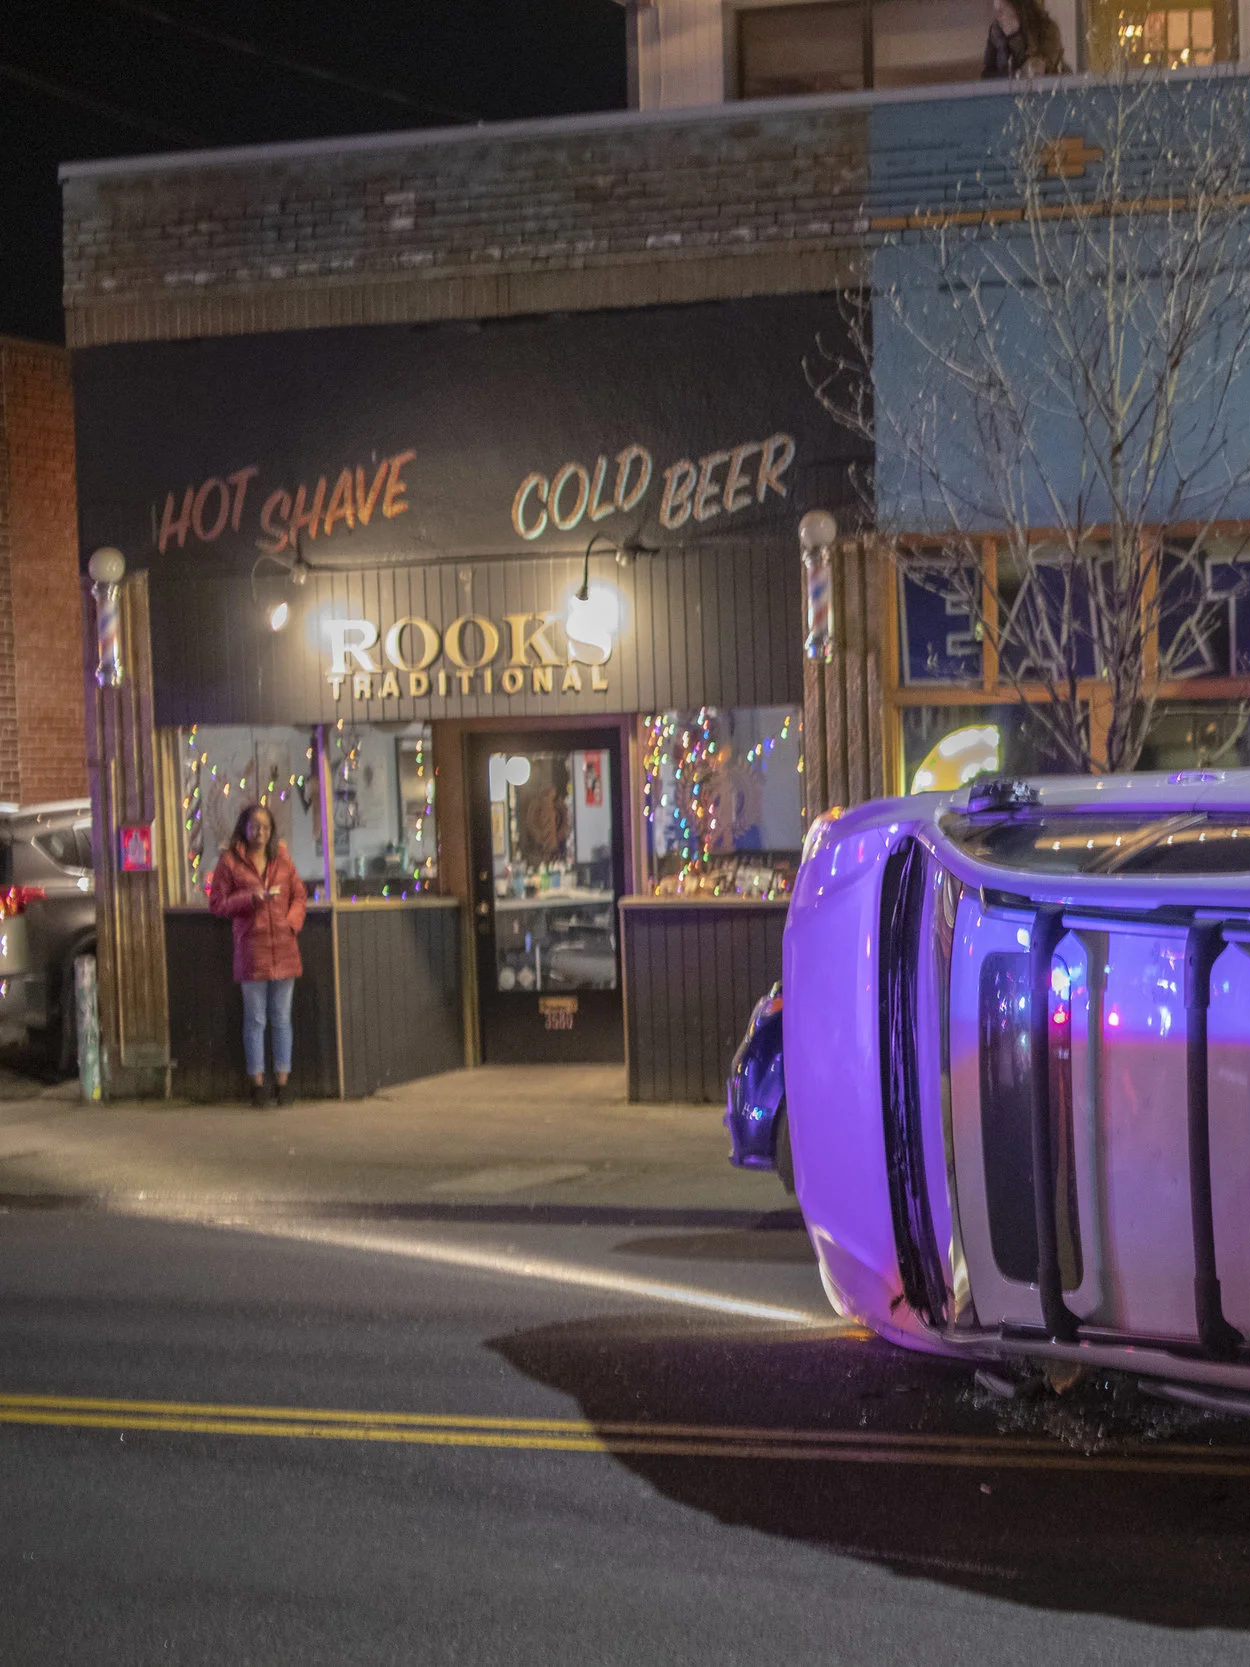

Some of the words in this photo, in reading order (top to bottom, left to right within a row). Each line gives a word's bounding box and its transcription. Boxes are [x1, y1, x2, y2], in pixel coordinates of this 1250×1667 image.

[158, 465, 260, 555] HOT
[254, 448, 417, 554] SHAVE
[511, 443, 653, 541] COLD
[658, 431, 797, 531] BEER
[323, 610, 613, 676] ROOKS
[325, 664, 610, 701] TRADITIONAL
